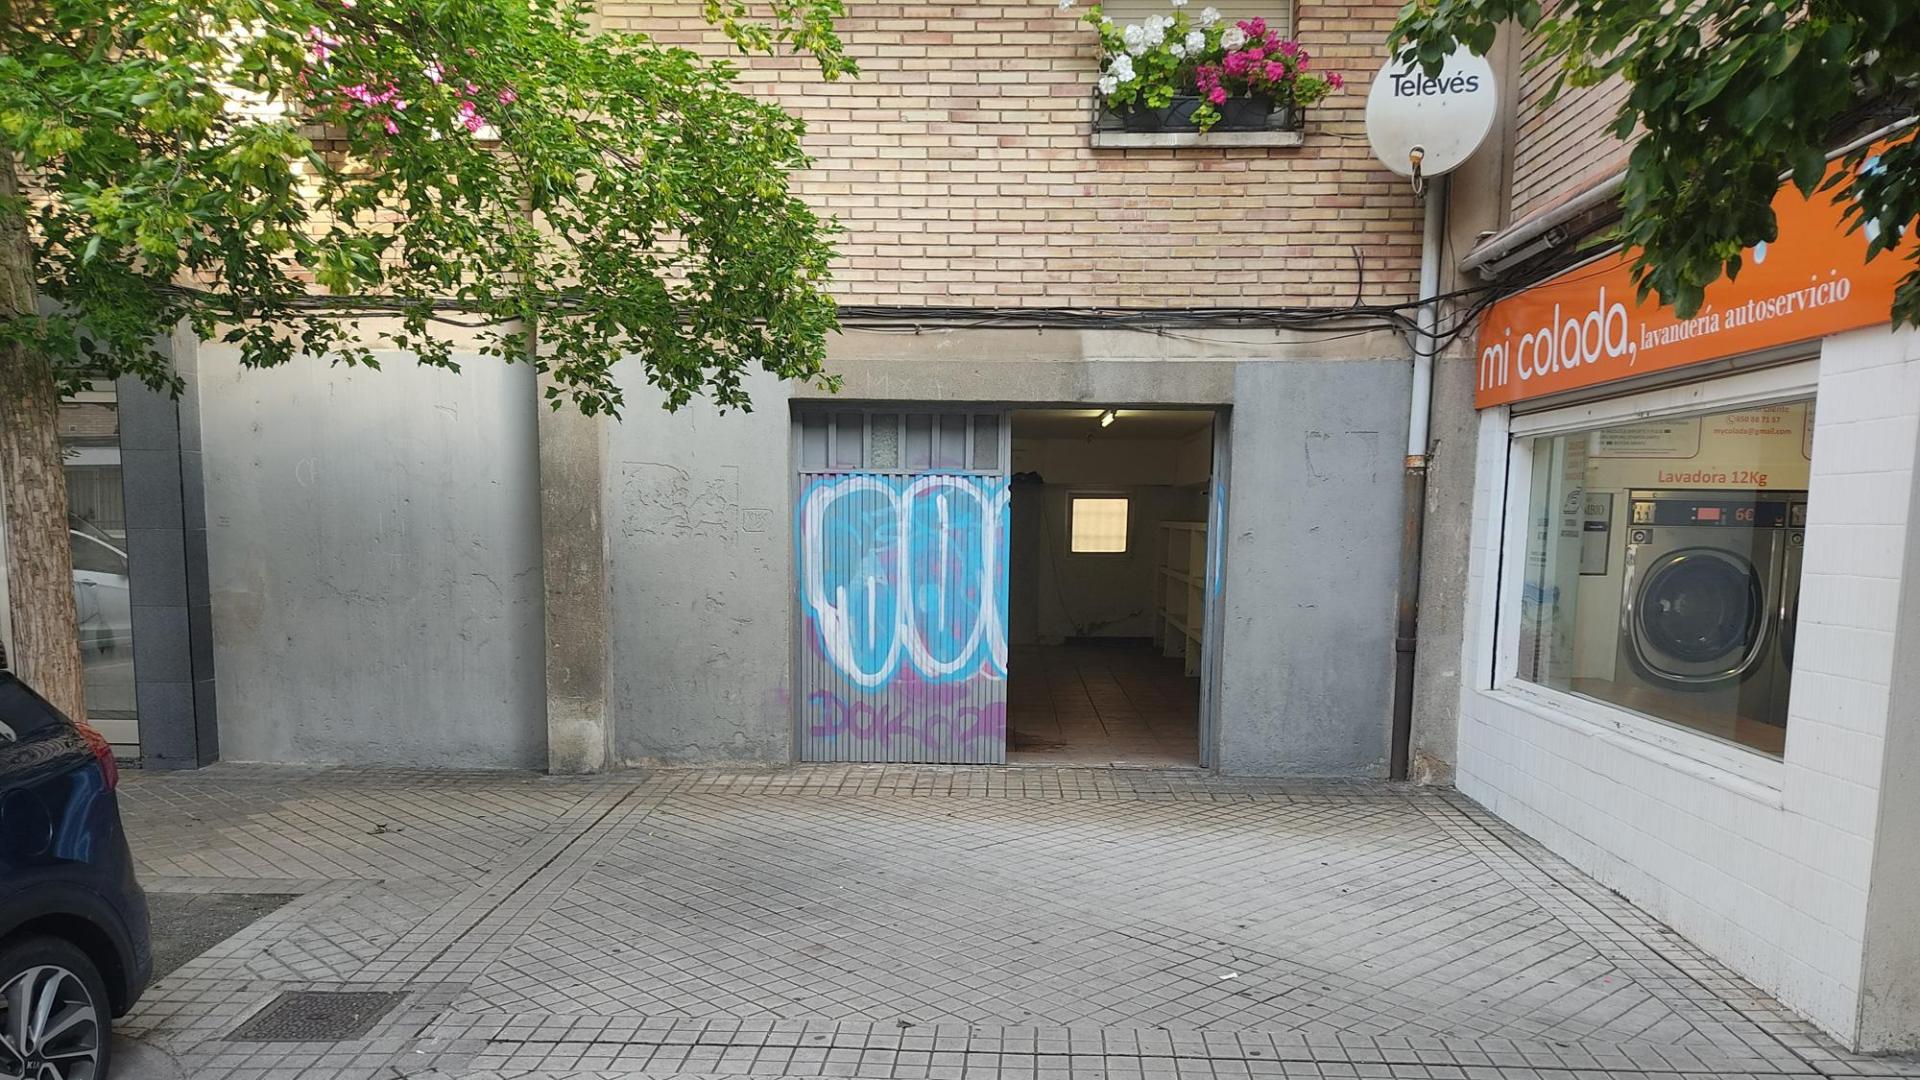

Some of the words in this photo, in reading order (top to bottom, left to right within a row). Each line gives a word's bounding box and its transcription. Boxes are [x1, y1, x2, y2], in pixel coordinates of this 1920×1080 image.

[1389, 70, 1480, 98] Televés
[1480, 327, 1512, 391] mi
[1517, 285, 1637, 381] colada,
[1640, 304, 1721, 351] lavandería
[1724, 268, 1851, 330] autoservicio
[1658, 469, 1726, 484] Lavadora
[1731, 470, 1768, 487] 12Kg
